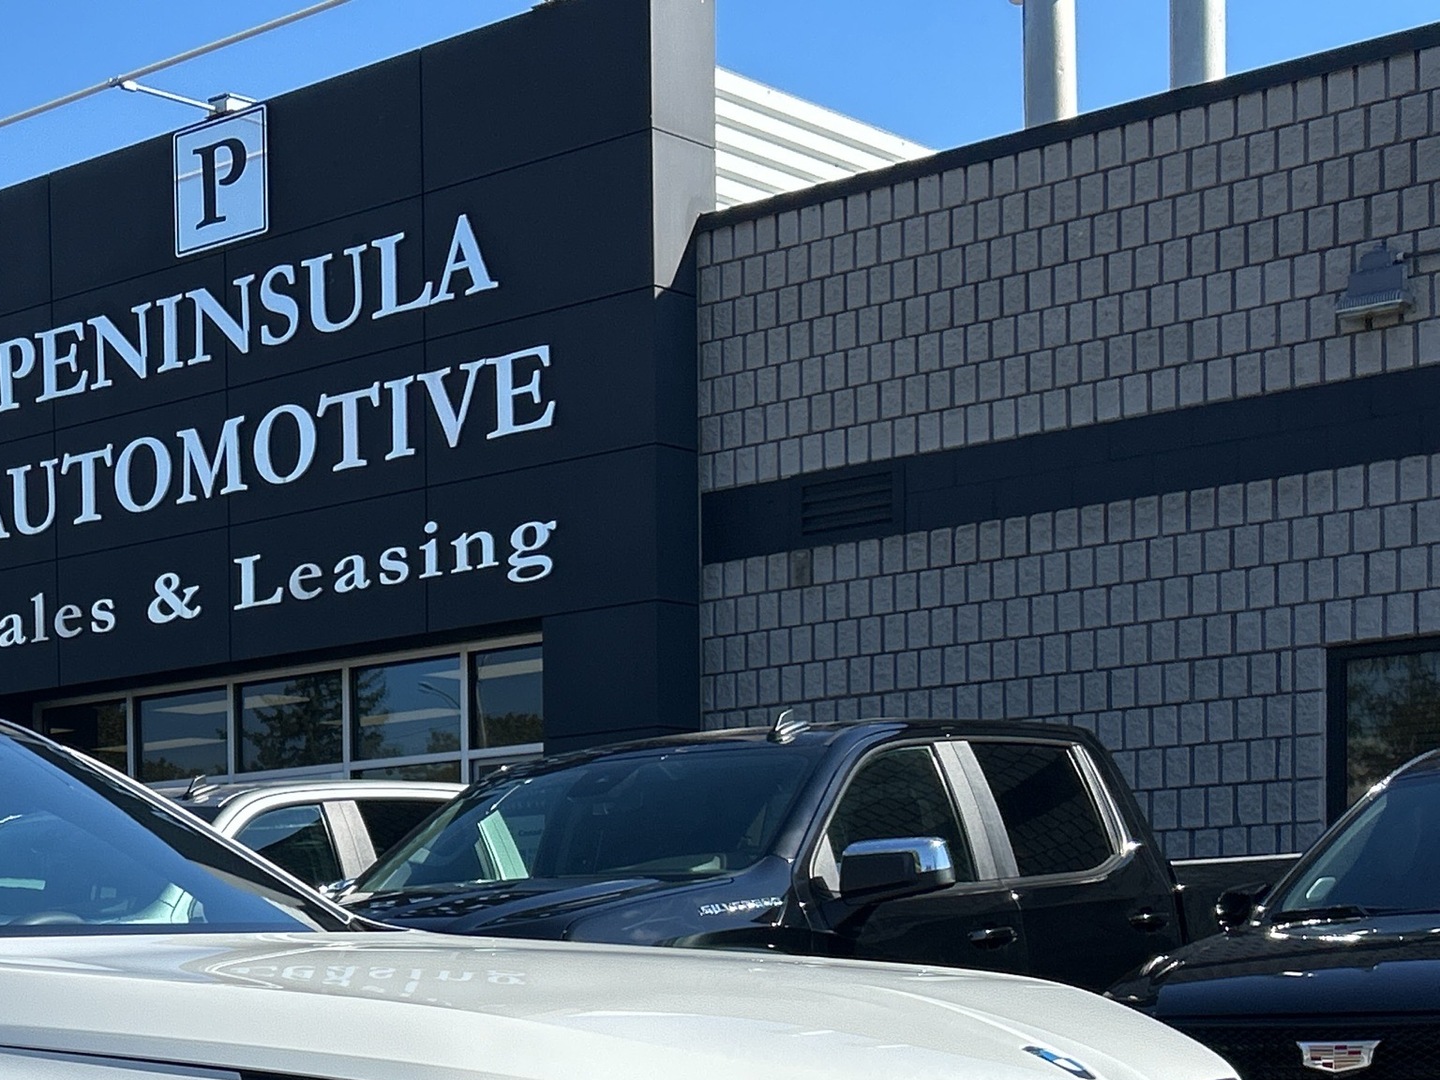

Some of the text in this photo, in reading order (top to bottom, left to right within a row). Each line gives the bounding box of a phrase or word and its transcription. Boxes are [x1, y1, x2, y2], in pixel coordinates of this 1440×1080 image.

[192, 137, 247, 230] P
[147, 570, 201, 624] &
[233, 520, 557, 610] Leasing
